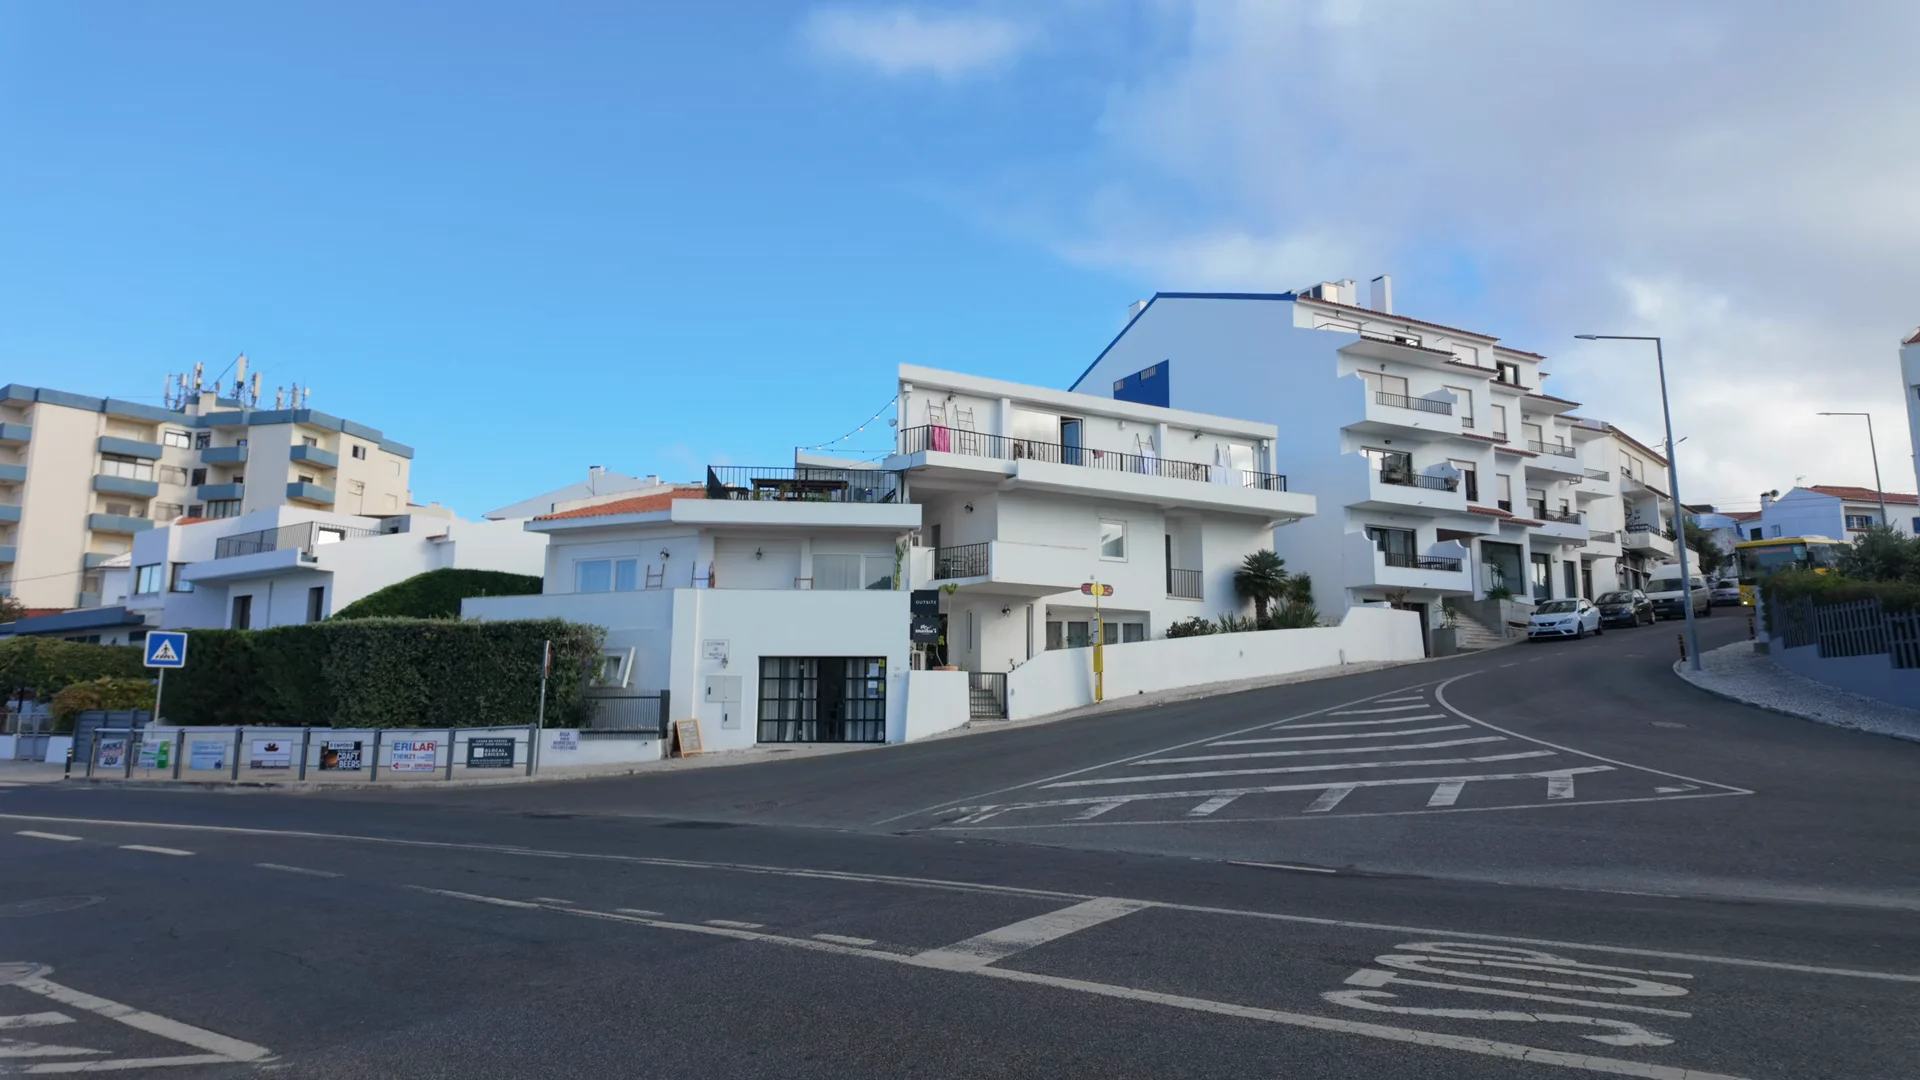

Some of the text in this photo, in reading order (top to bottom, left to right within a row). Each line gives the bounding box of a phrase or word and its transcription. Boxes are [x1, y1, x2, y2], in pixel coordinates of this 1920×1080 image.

[393, 742, 435, 751] ERILAR
[337, 752, 359, 760] CRAFT
[339, 760, 361, 768] BEERS
[1320, 941, 1694, 1046] STOP
